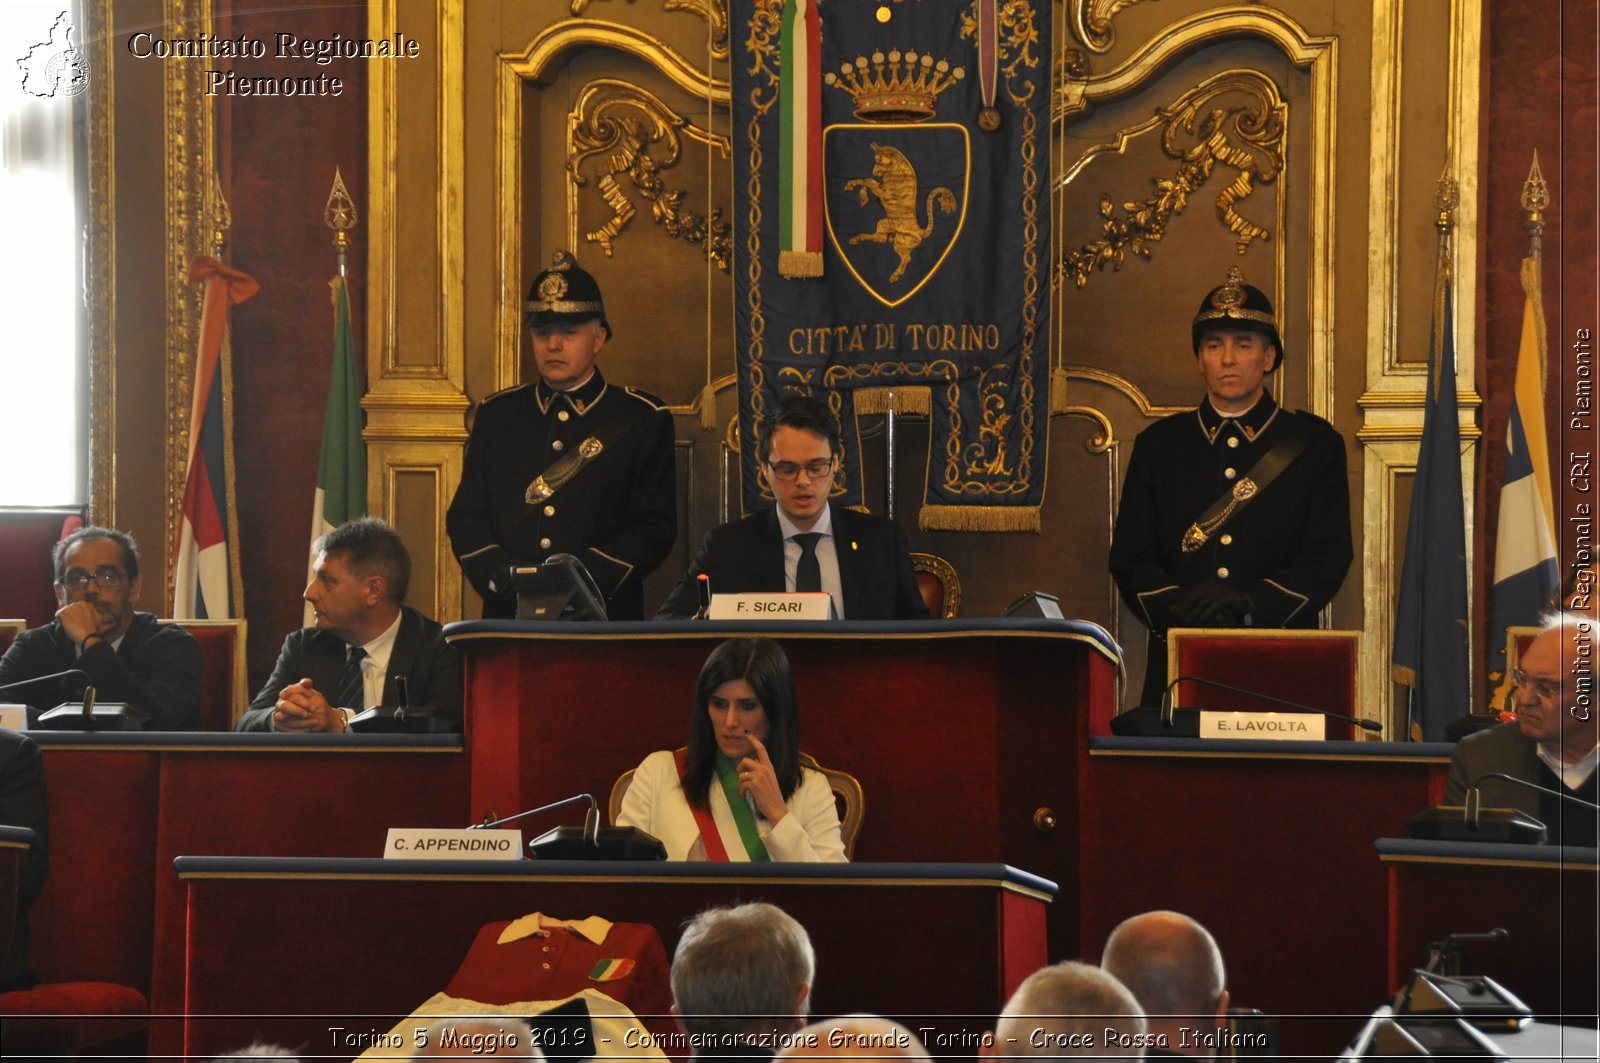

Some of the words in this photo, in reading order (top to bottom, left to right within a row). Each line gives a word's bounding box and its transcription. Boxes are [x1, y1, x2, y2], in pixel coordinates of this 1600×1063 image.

[875, 323, 895, 349] DI
[905, 324, 1000, 350] TORINO
[737, 602, 749, 612] F.
[753, 602, 802, 612] SICARI
[1217, 720, 1231, 731] E.
[1236, 721, 1308, 732] LAVOLTA
[394, 838, 409, 850] C.
[414, 838, 511, 851] APPENDINO
